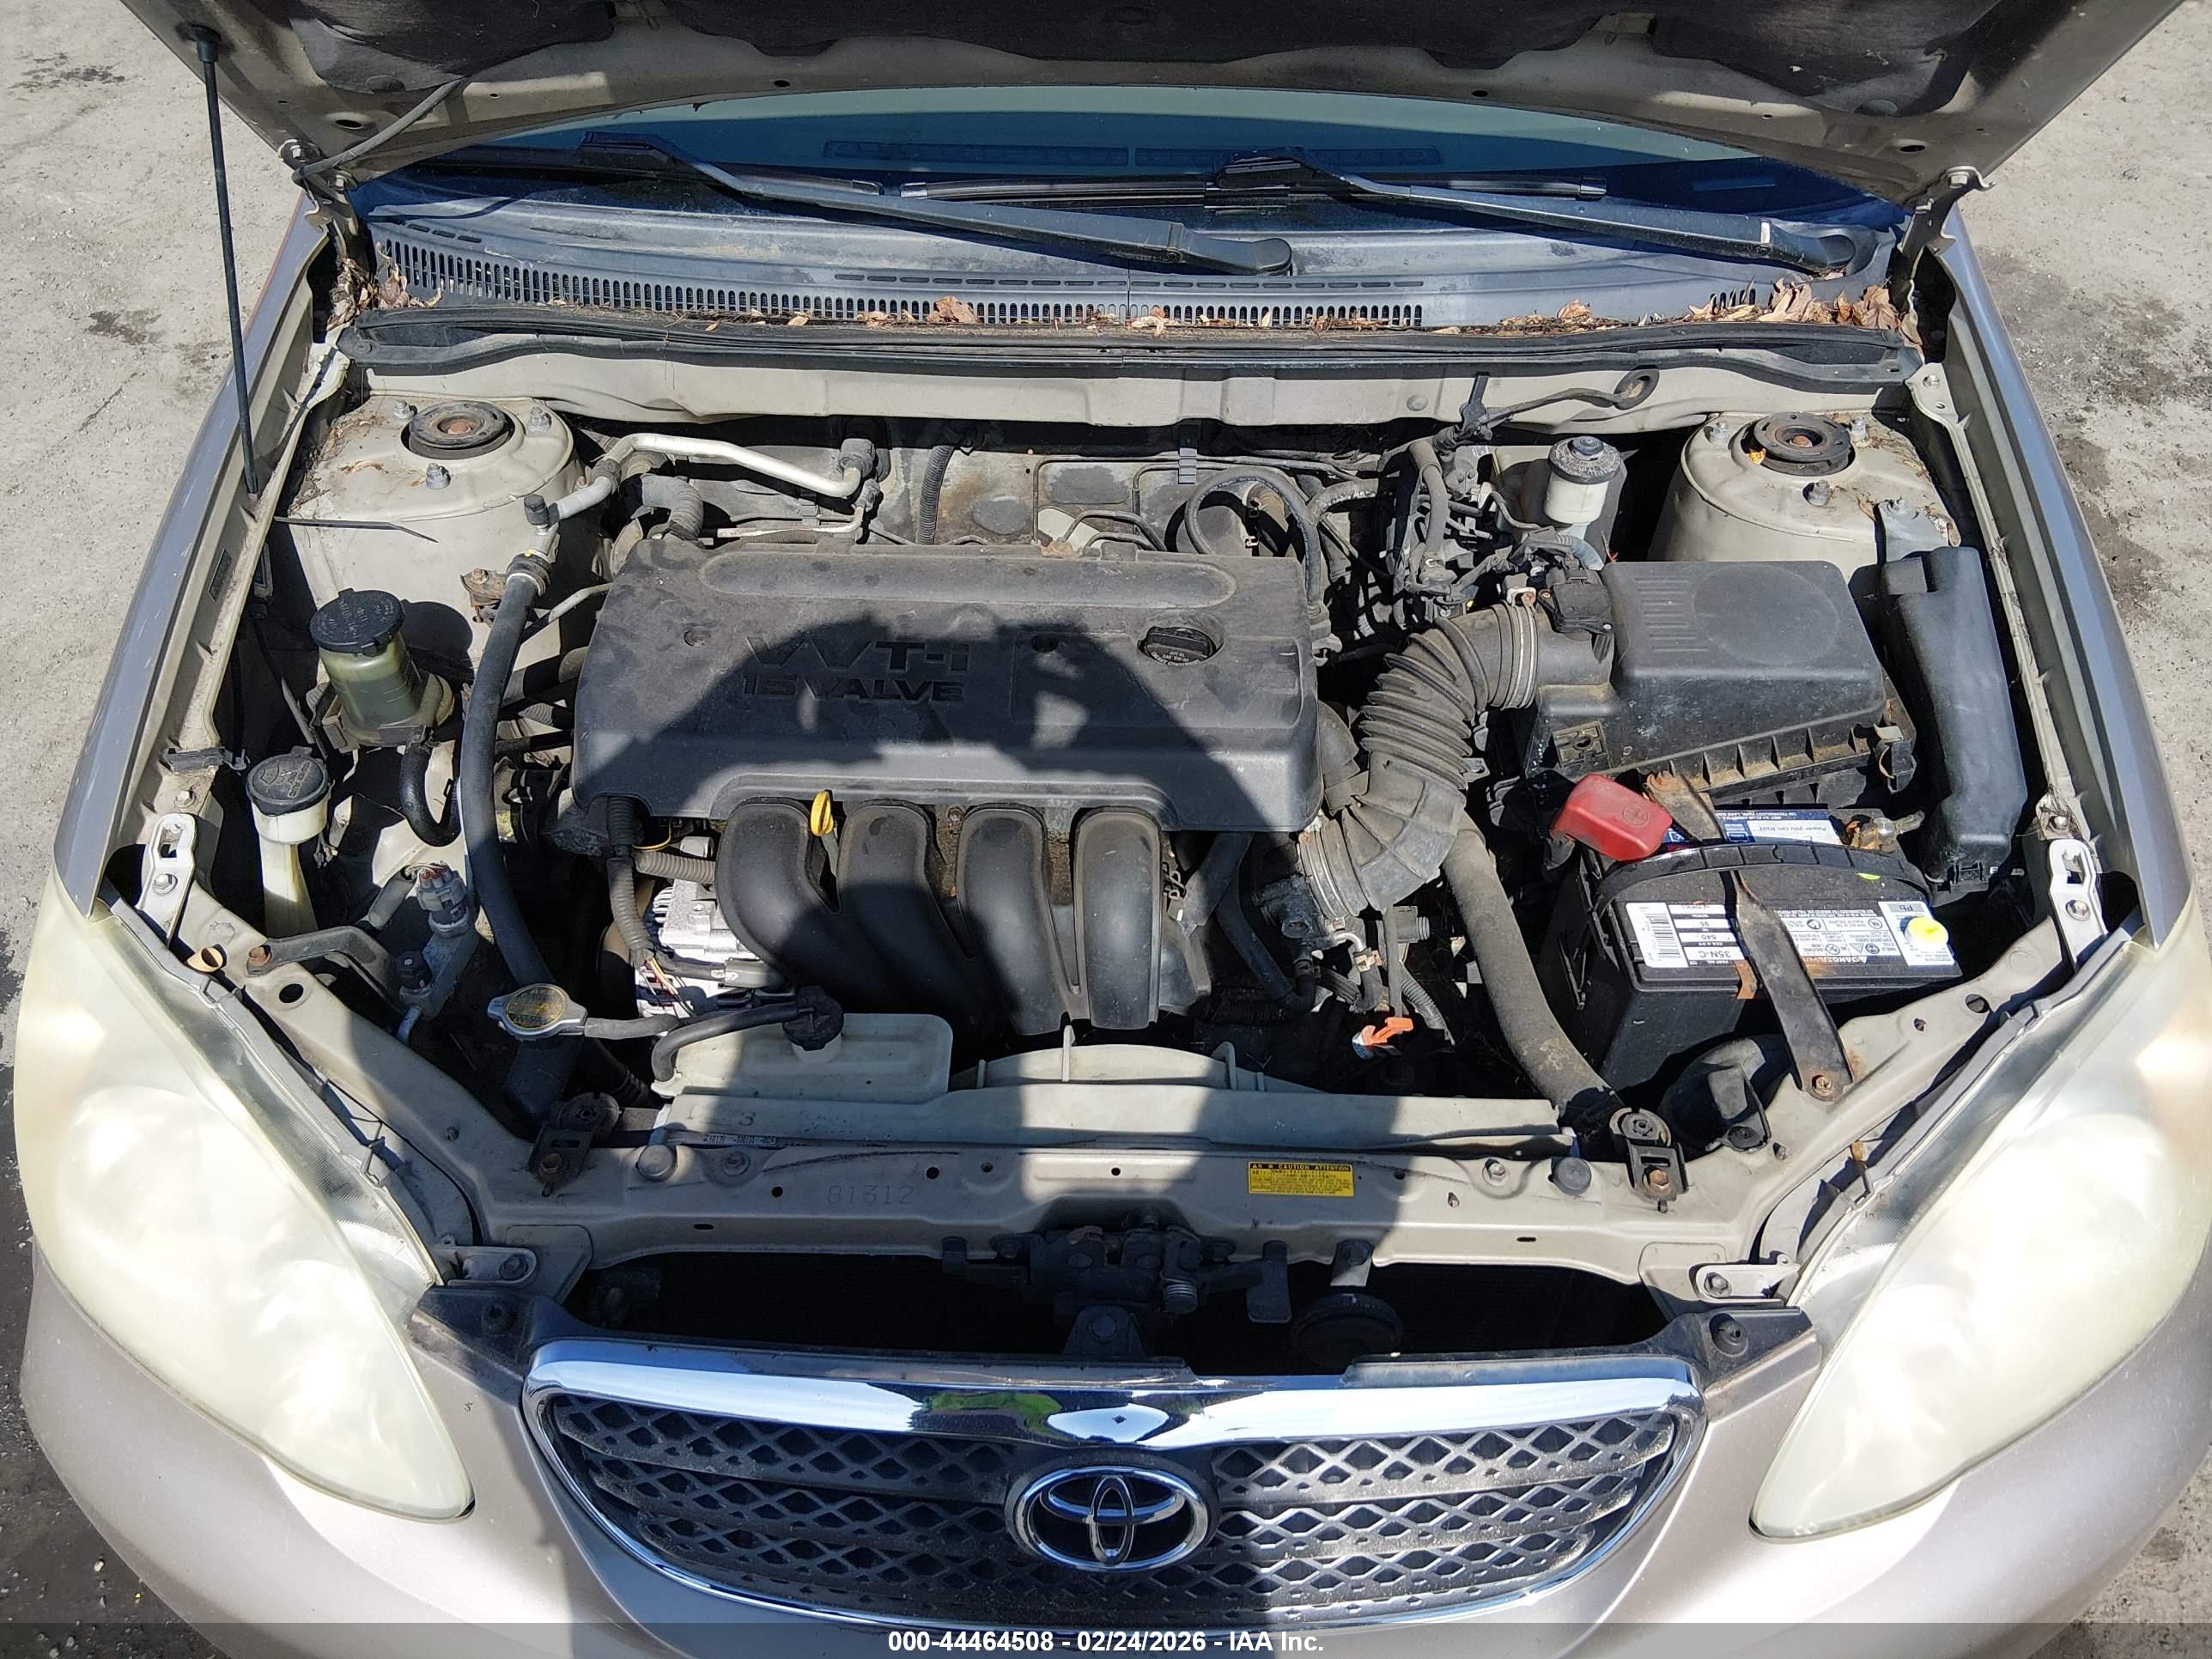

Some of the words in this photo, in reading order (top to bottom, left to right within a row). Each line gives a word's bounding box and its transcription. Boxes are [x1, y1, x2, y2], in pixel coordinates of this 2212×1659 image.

[803, 678, 965, 702] VALVE
[1698, 950, 1731, 958] 35N-C
[826, 1184, 915, 1205] 81312
